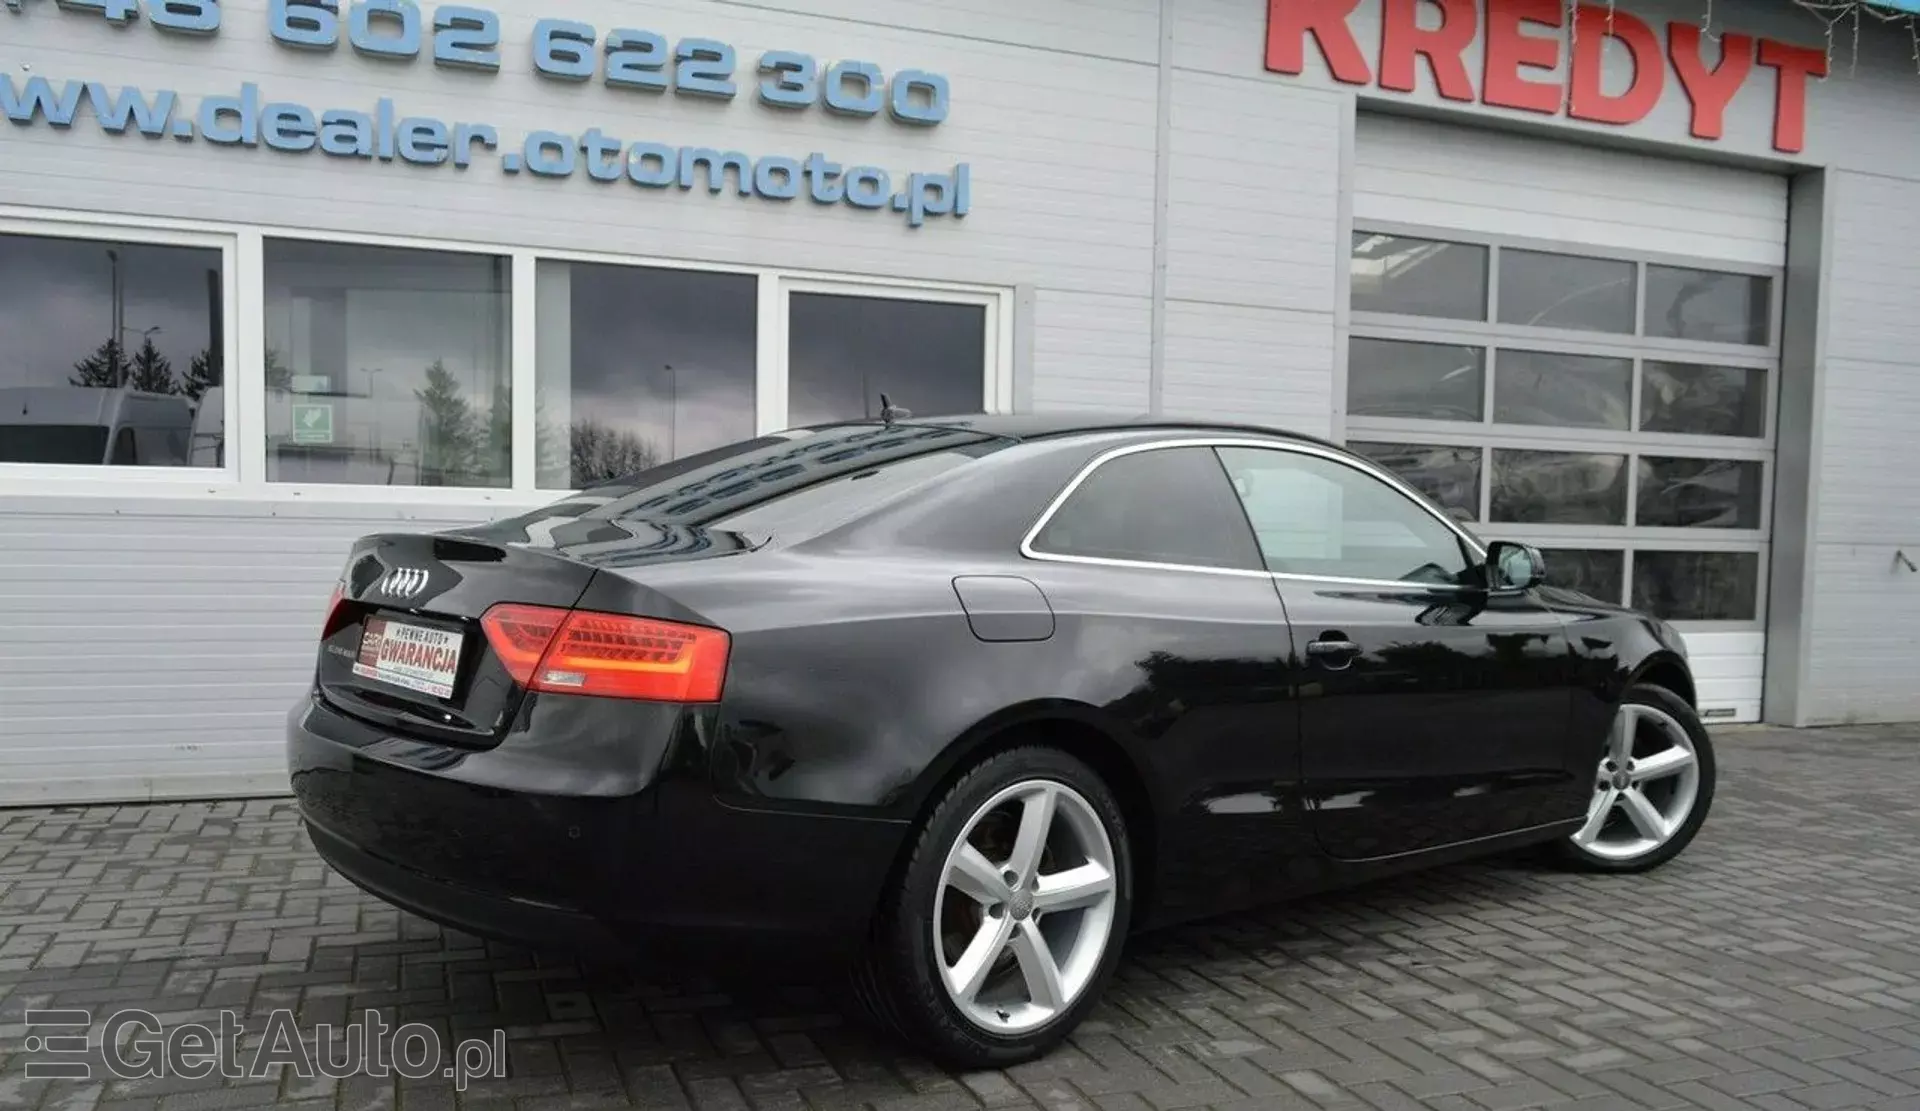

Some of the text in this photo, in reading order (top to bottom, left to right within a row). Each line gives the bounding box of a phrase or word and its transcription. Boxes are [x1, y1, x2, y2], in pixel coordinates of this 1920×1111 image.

[267, 0, 500, 71] 602
[533, 17, 737, 101] 622
[1264, 0, 1828, 153] KREDYT
[380, 637, 457, 675] GWARANCJA
